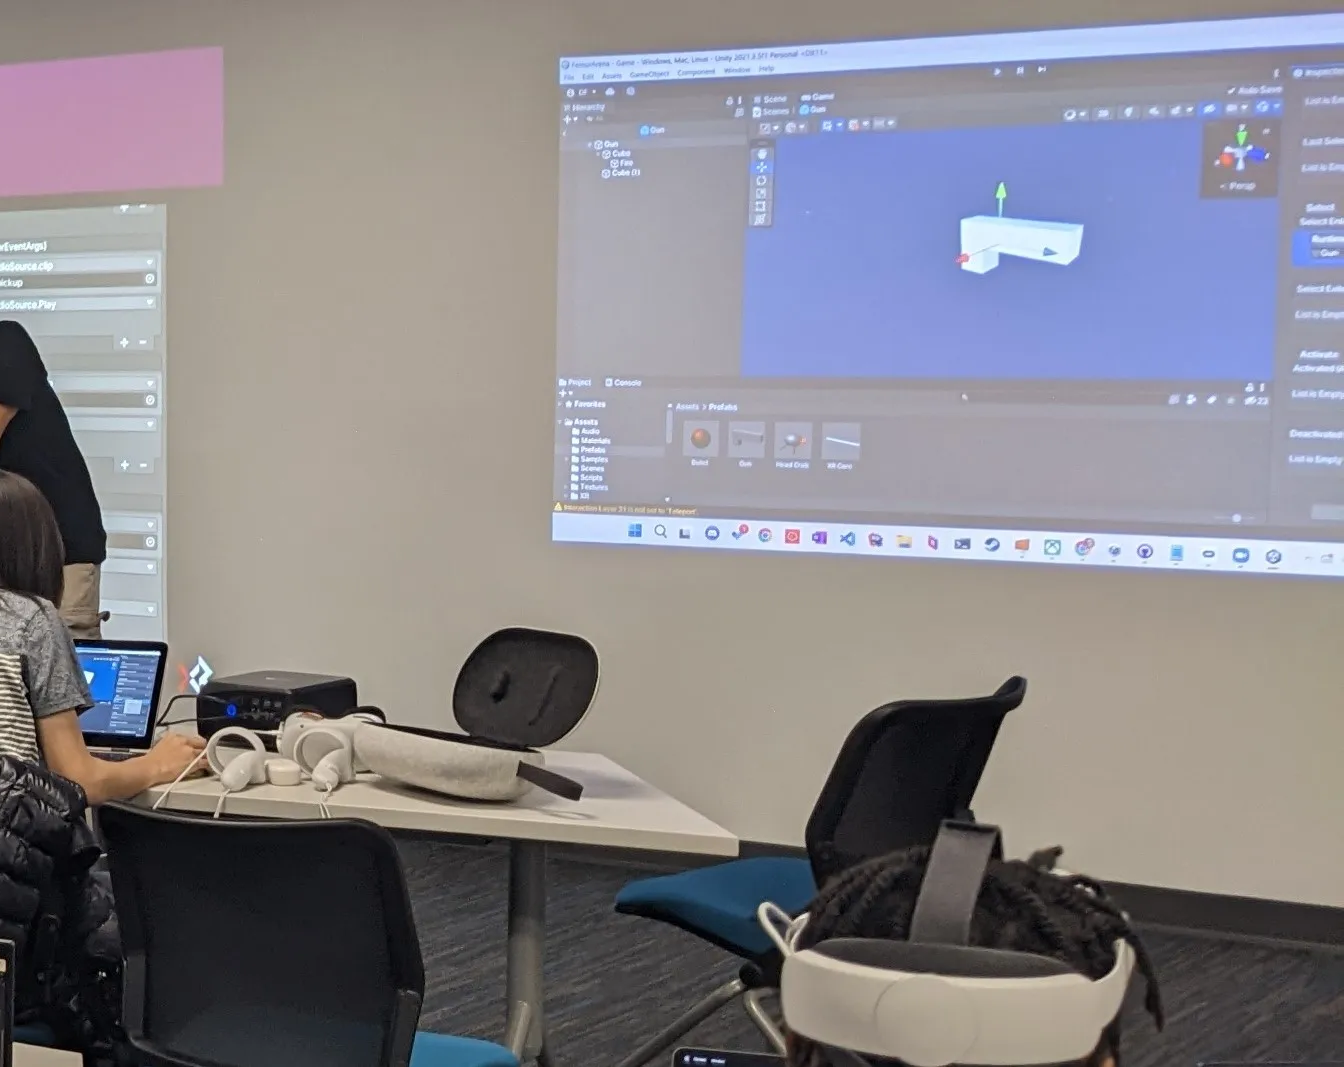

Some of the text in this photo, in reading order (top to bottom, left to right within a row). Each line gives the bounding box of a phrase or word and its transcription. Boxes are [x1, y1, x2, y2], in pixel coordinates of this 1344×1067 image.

[763, 95, 788, 104] Scene
[811, 92, 835, 101] Game
[568, 379, 592, 388] Project
[614, 379, 642, 387] Console
[573, 400, 606, 408] Favorites
[574, 418, 599, 426] Assets
[580, 446, 606, 454] Prefabs
[580, 456, 609, 464] Samples
[580, 474, 603, 482] Scripts
[580, 484, 609, 492] Textures
